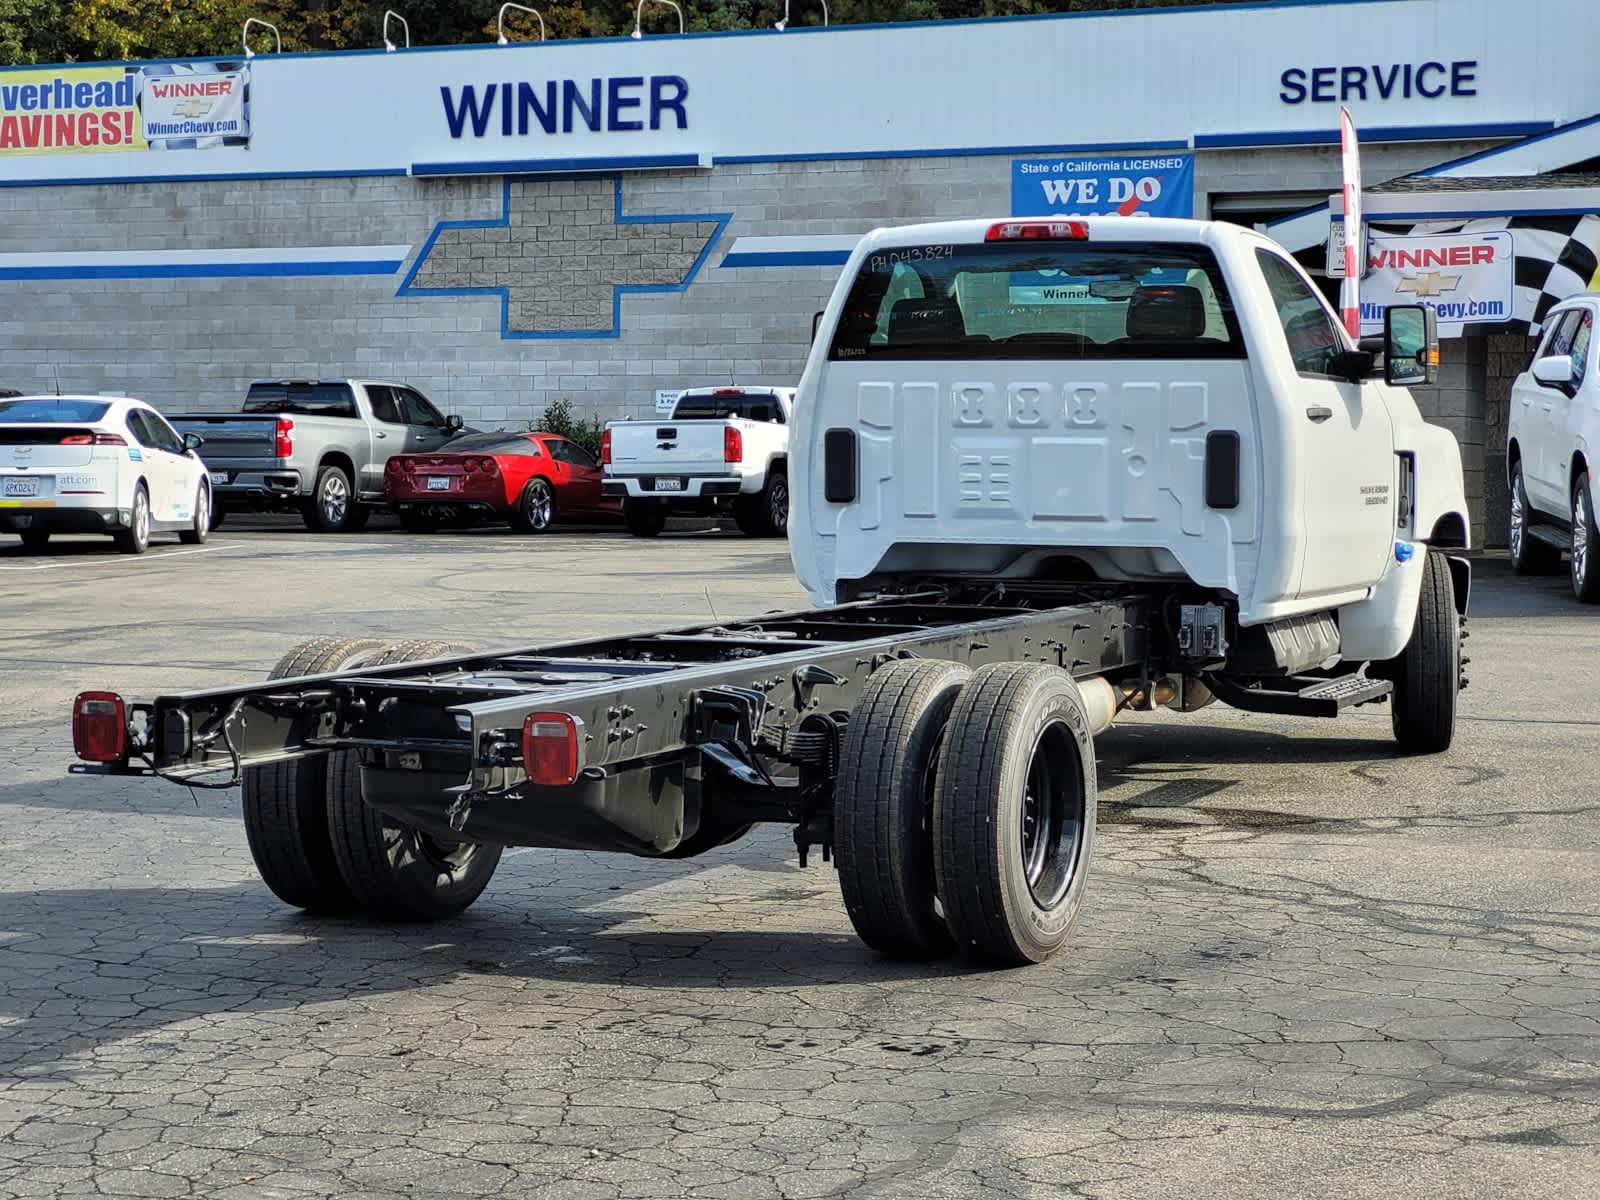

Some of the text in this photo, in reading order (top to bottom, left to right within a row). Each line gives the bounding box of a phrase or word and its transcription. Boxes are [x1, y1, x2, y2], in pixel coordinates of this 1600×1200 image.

[151, 80, 232, 98] WINNER
[1279, 60, 1478, 104] SERVICE
[439, 74, 689, 138] WINNER
[0, 111, 134, 149] AVINGS!
[147, 119, 238, 135] WinnerChevy.com
[1020, 158, 1183, 173] State of California LICENSED
[1040, 176, 1161, 205] WE DO
[1367, 245, 1495, 269] WINNER
[1043, 288, 1089, 300] Winner
[60, 474, 97, 485] att.com
